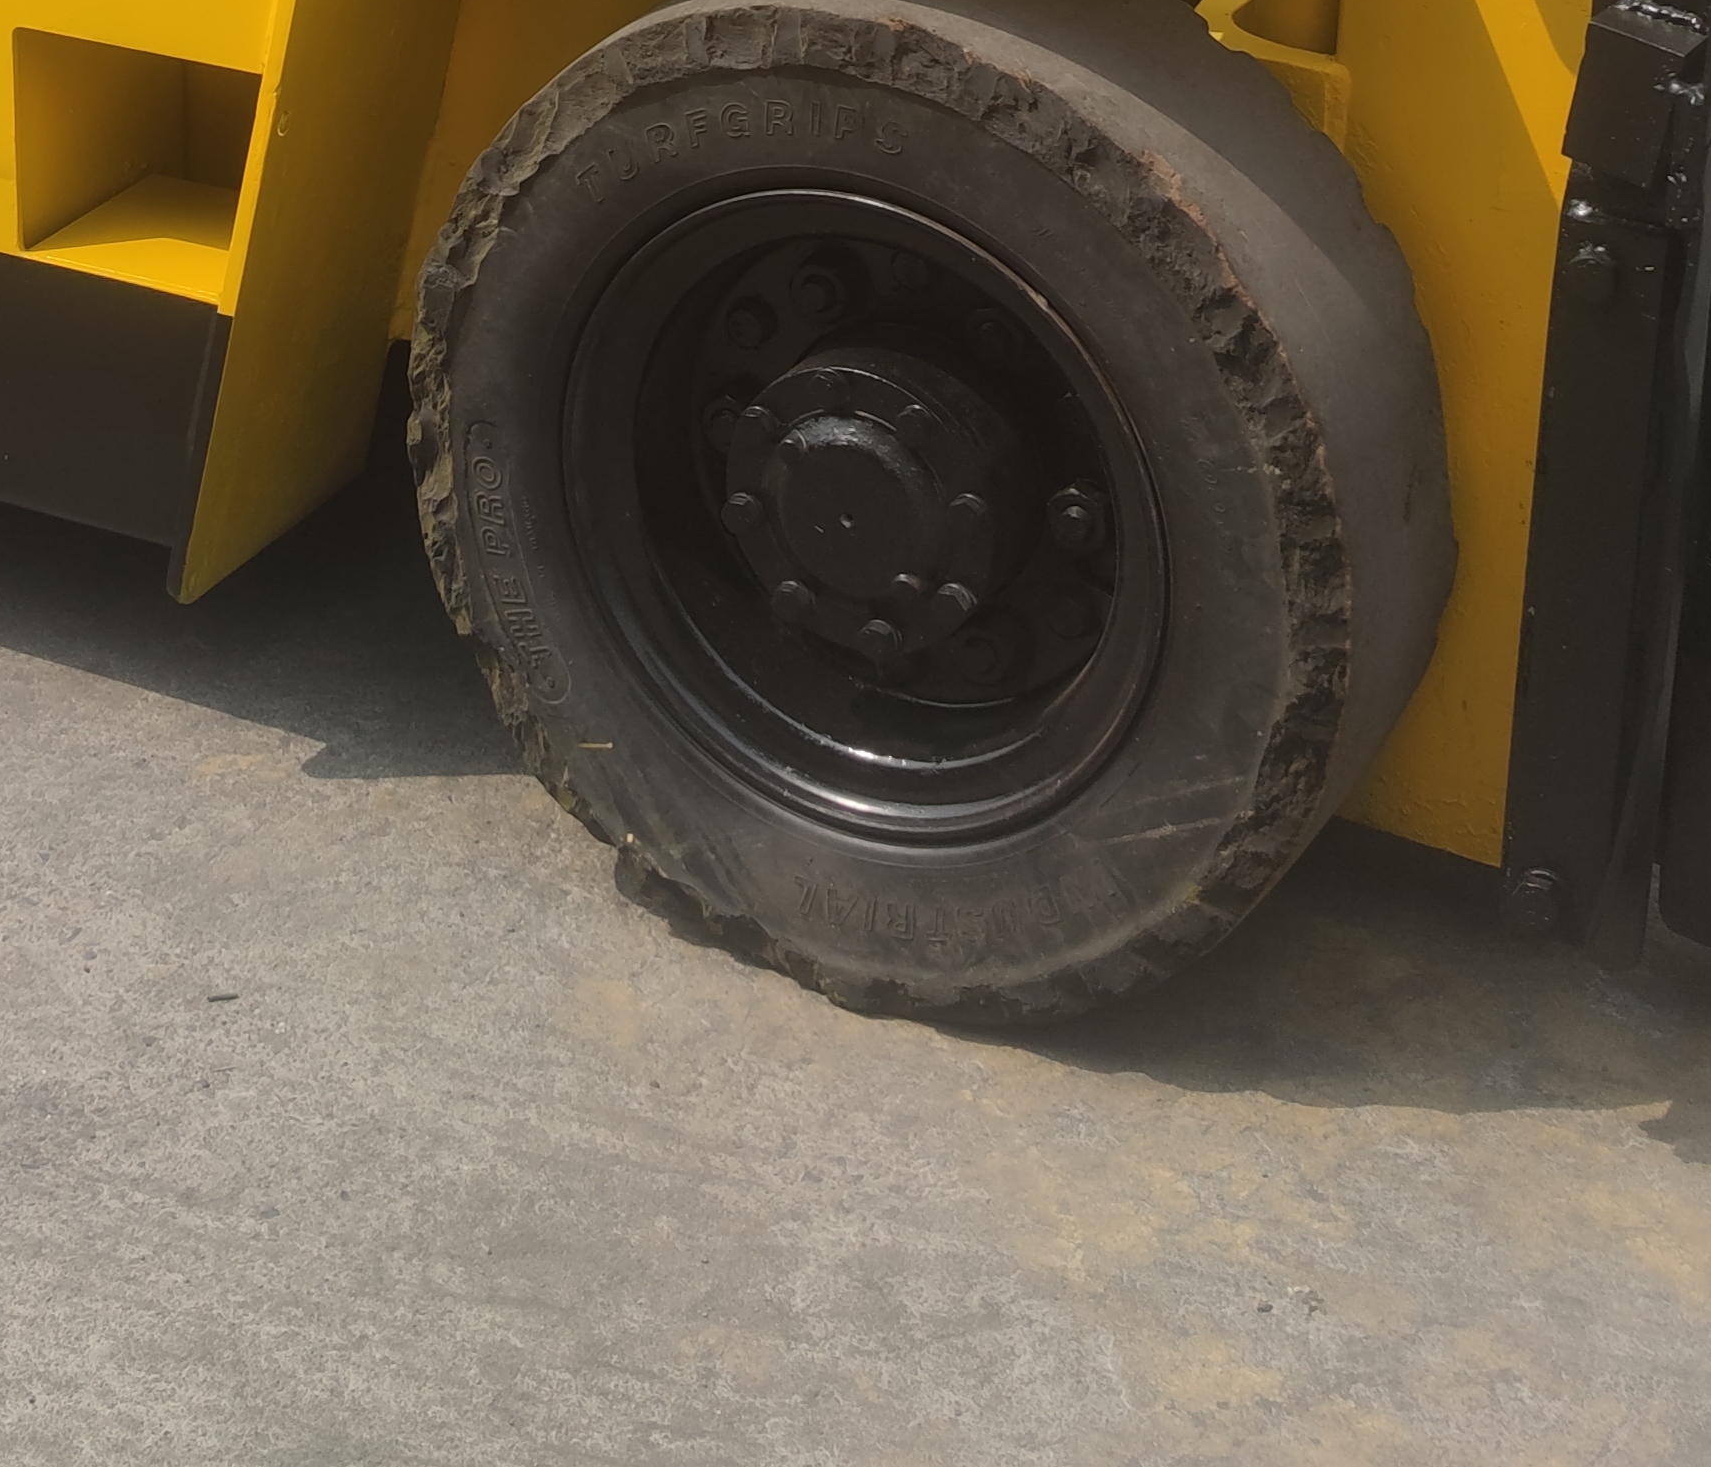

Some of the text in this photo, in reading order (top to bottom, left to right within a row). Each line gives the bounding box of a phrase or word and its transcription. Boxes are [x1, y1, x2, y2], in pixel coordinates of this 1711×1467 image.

[574, 98, 911, 204] TURFGRIPS
[471, 455, 511, 557] PRO
[488, 570, 551, 669] THE
[799, 874, 1129, 954] NDUSTRIAL
